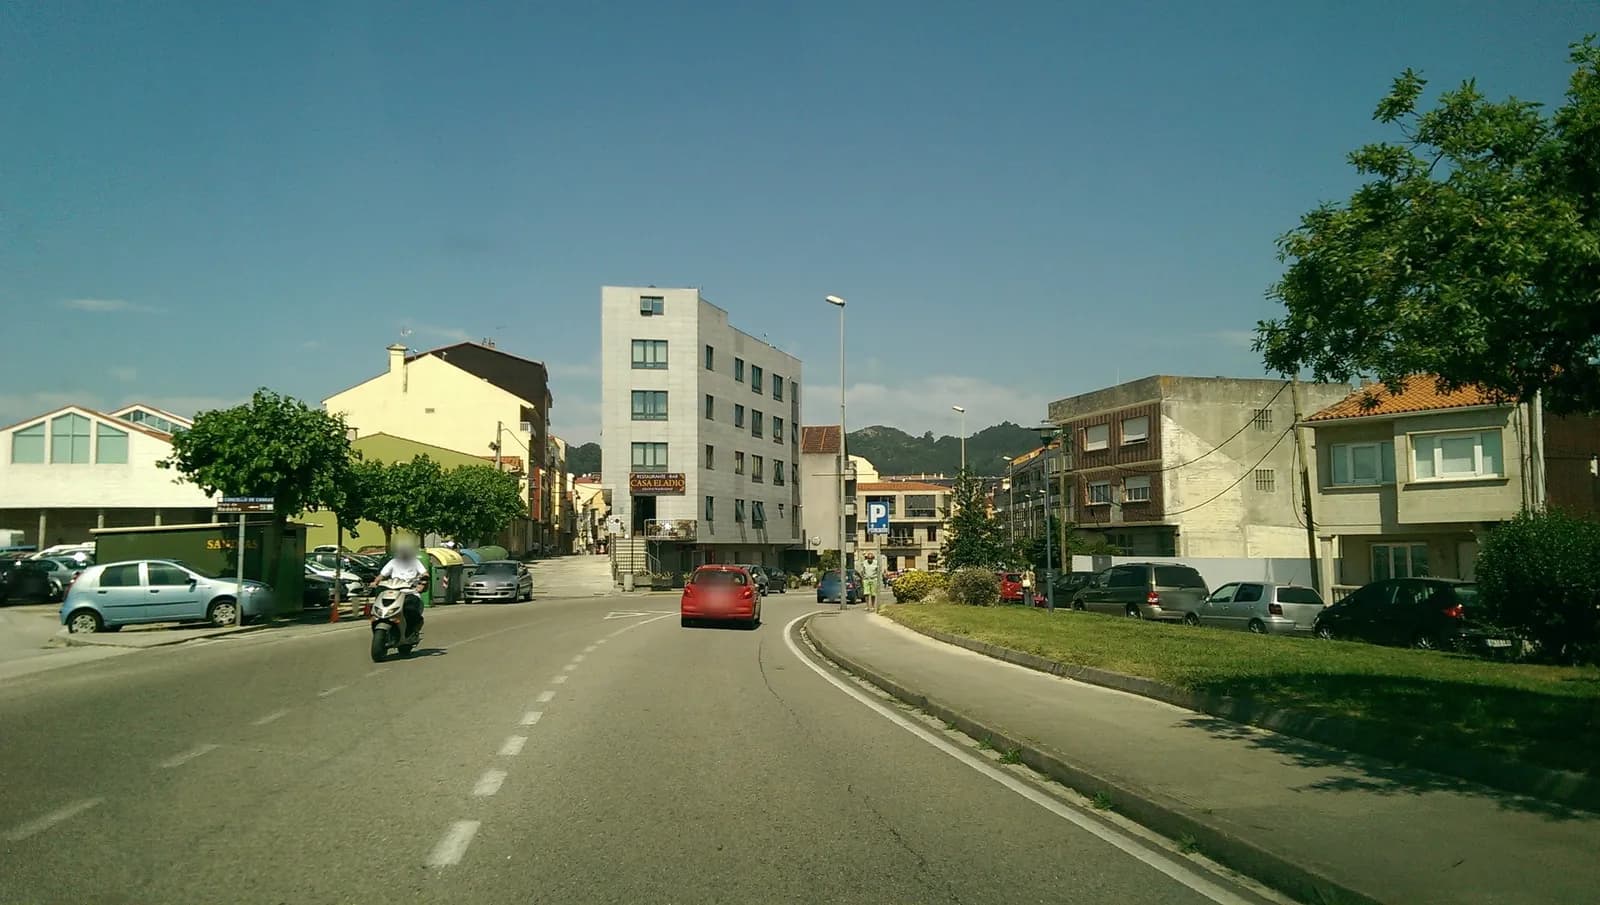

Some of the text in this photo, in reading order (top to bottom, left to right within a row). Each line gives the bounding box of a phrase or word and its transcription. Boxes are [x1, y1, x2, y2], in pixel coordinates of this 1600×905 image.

[630, 479, 685, 487] CASA ELADIO
[870, 504, 886, 523] P
